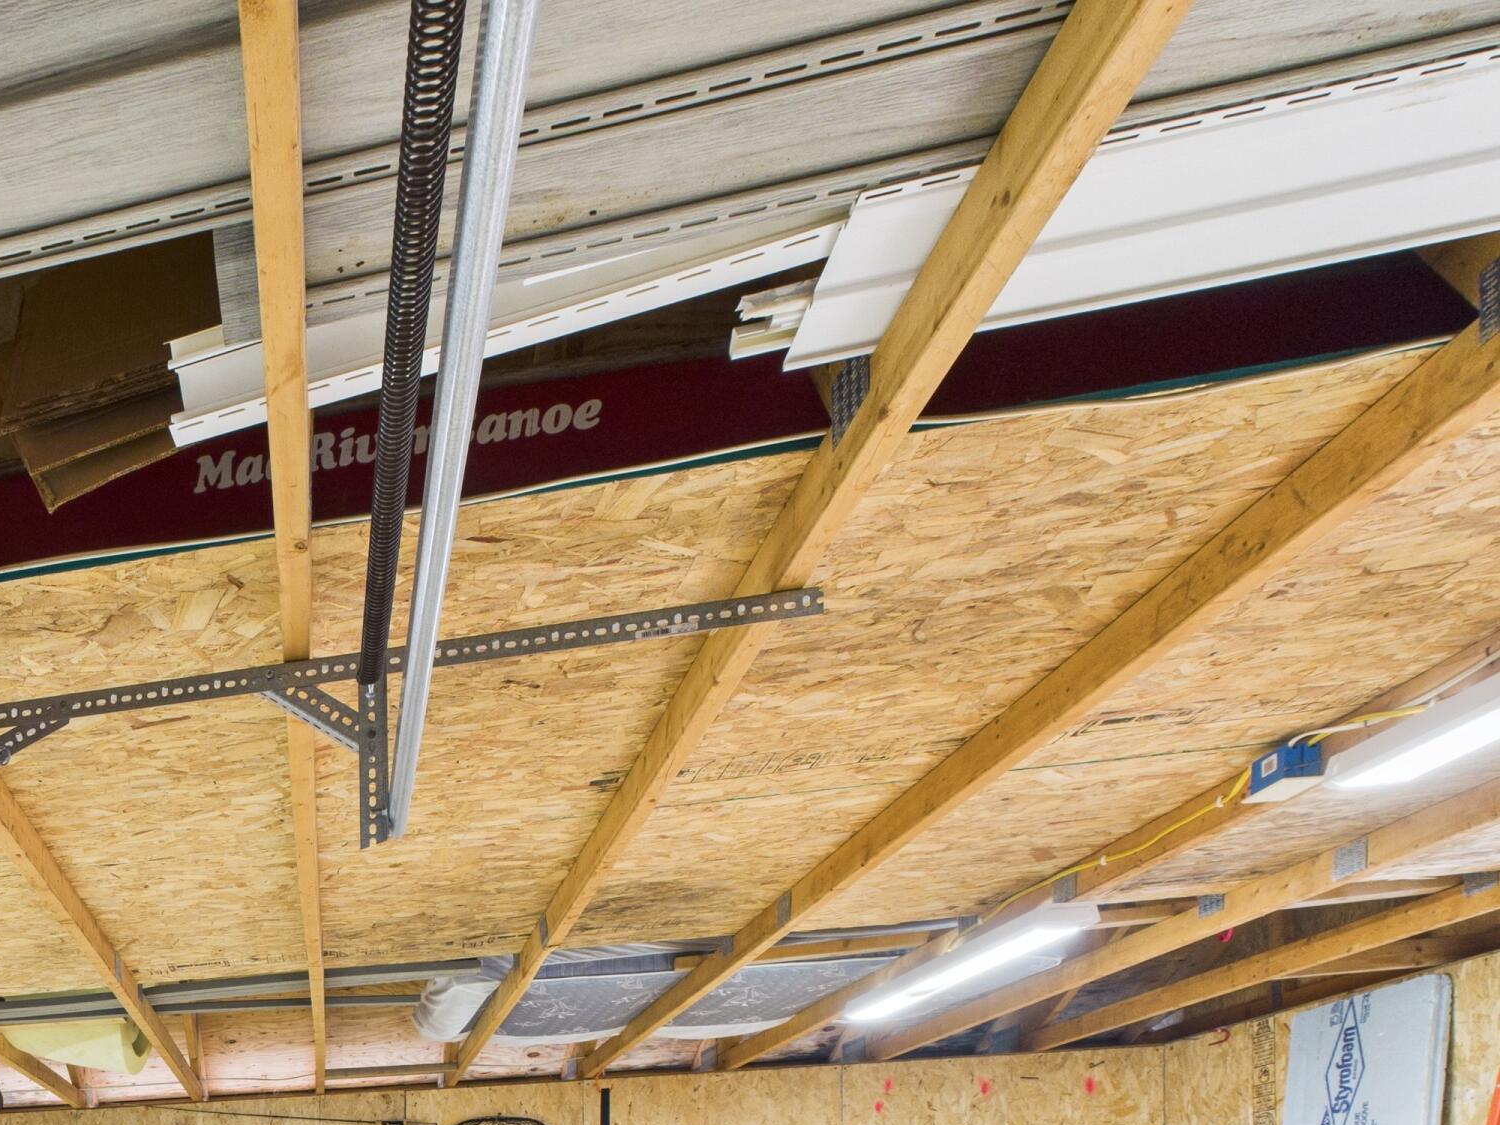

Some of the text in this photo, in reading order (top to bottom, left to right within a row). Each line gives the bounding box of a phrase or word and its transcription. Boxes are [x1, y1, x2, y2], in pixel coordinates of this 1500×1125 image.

[193, 398, 603, 494] Ma Rivr anoe
[1332, 1025, 1358, 1115] Styrofoam
